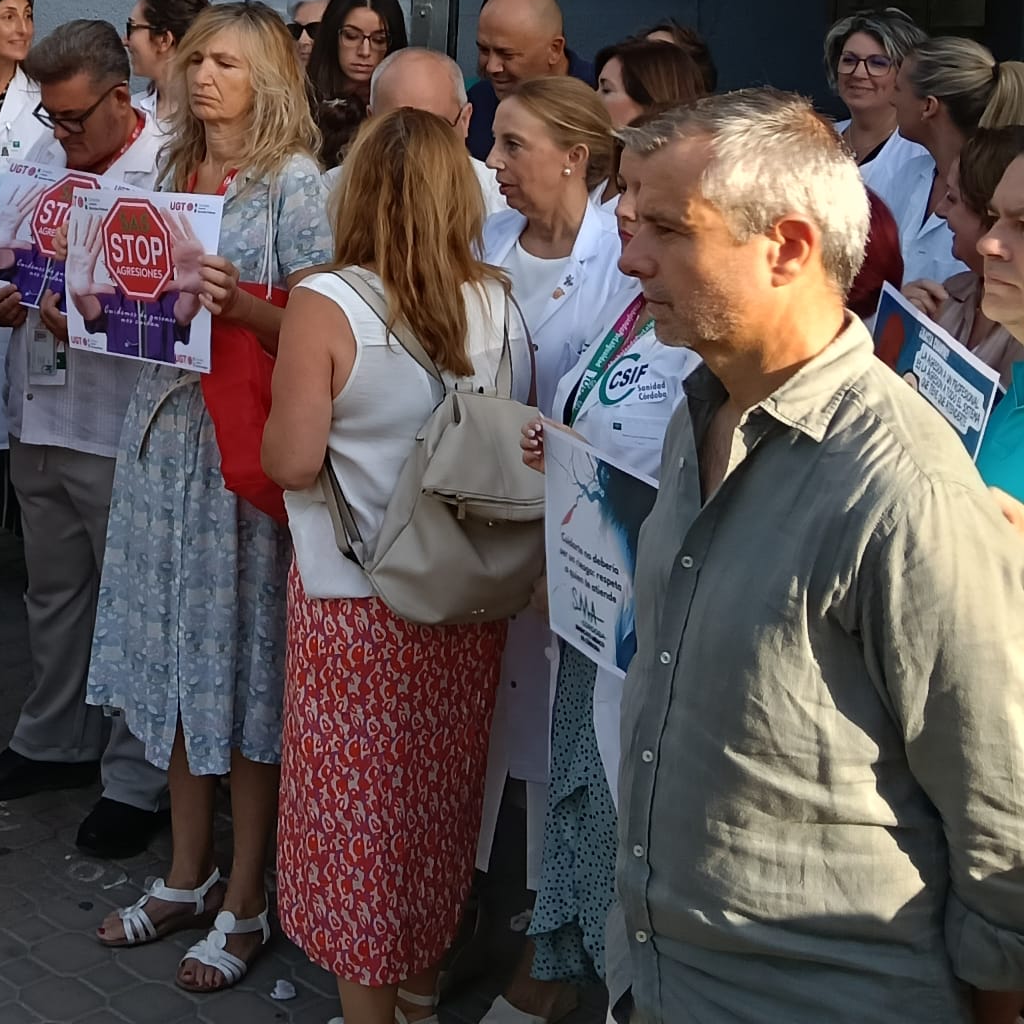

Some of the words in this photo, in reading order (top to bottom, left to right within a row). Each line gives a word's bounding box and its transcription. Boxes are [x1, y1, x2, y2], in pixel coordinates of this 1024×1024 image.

[9, 162, 29, 176] UGT
[170, 201, 186, 212] UGT
[110, 232, 164, 266] STOP
[115, 265, 164, 280] AGRESIONES
[608, 363, 649, 391] CSIF
[637, 381, 666, 392] Sanidad
[638, 390, 667, 402] Córdoba
